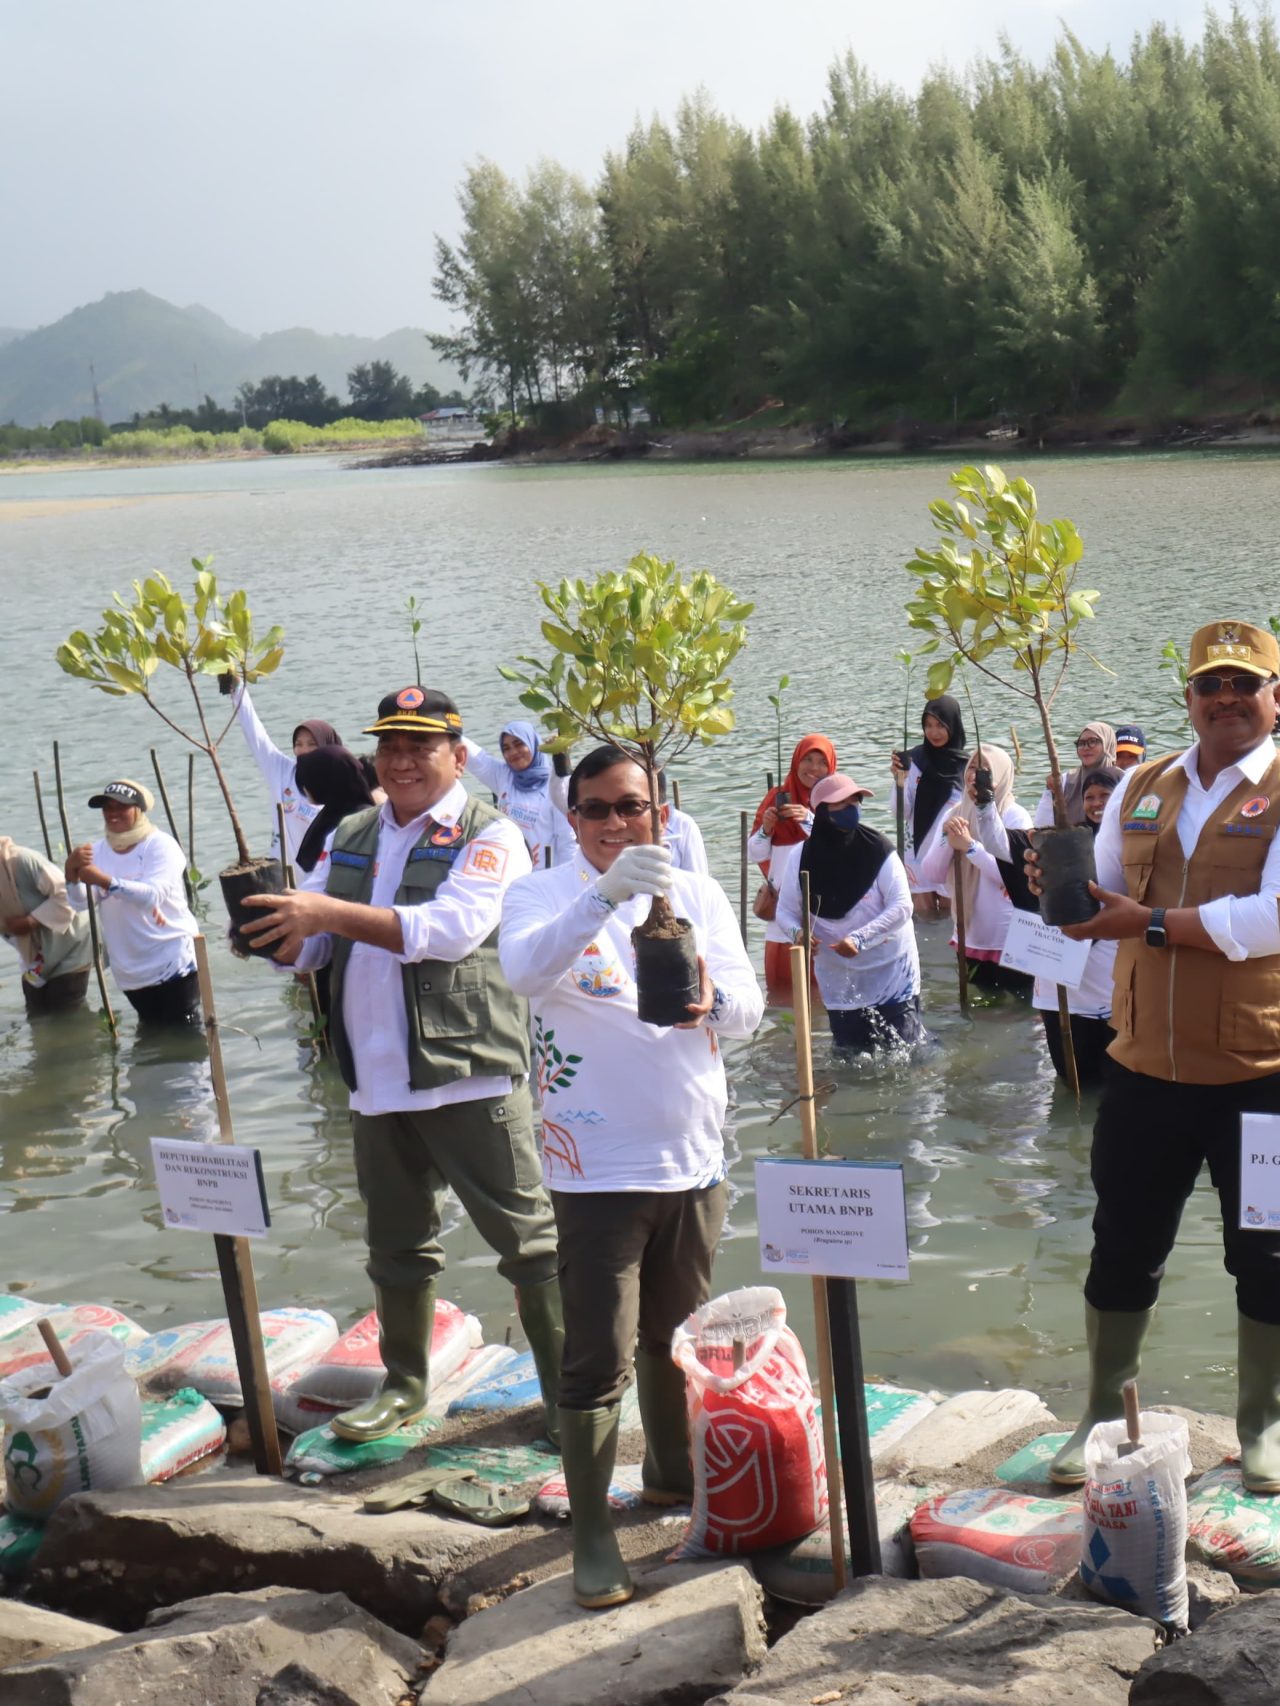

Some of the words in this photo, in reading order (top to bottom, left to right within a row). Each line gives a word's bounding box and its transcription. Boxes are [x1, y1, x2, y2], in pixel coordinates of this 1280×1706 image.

[159, 1151, 189, 1162] DEPUTI
[191, 1154, 249, 1168] REHABILITASI
[1251, 1153, 1269, 1165] PJ.
[165, 1164, 183, 1173] DAN
[183, 1166, 248, 1180] REKONSTRUKSI
[197, 1179, 219, 1189] BNPB
[788, 1184, 871, 1199] SEKRETARIS
[788, 1202, 836, 1216] UTAMA
[840, 1205, 874, 1217] BNPB
